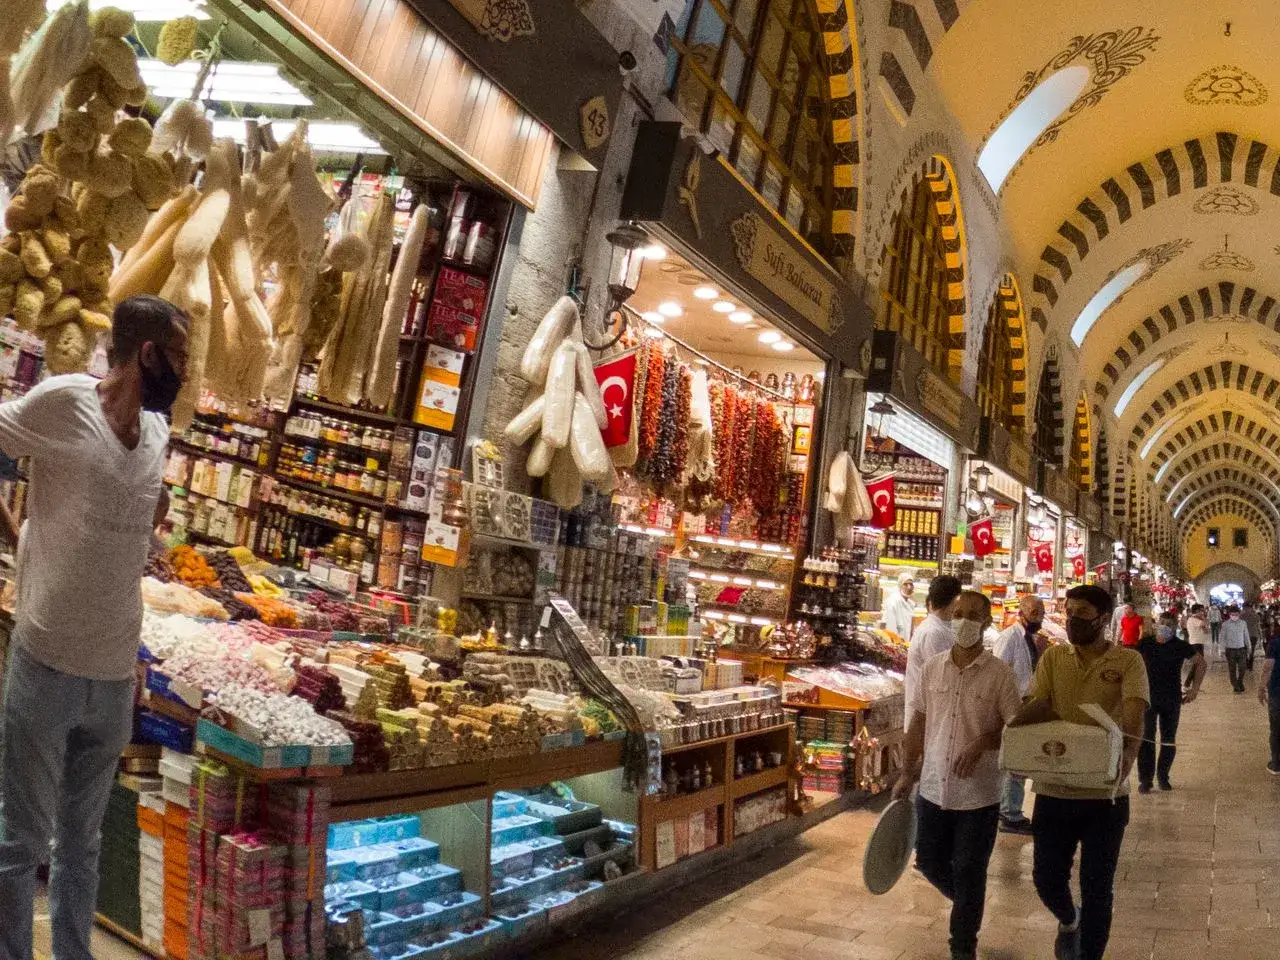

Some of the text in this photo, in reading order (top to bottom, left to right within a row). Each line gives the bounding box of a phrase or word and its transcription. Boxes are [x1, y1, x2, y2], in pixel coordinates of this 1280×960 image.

[587, 107, 606, 138] 43
[443, 268, 466, 285] TEA
[785, 263, 823, 308] Baharat
